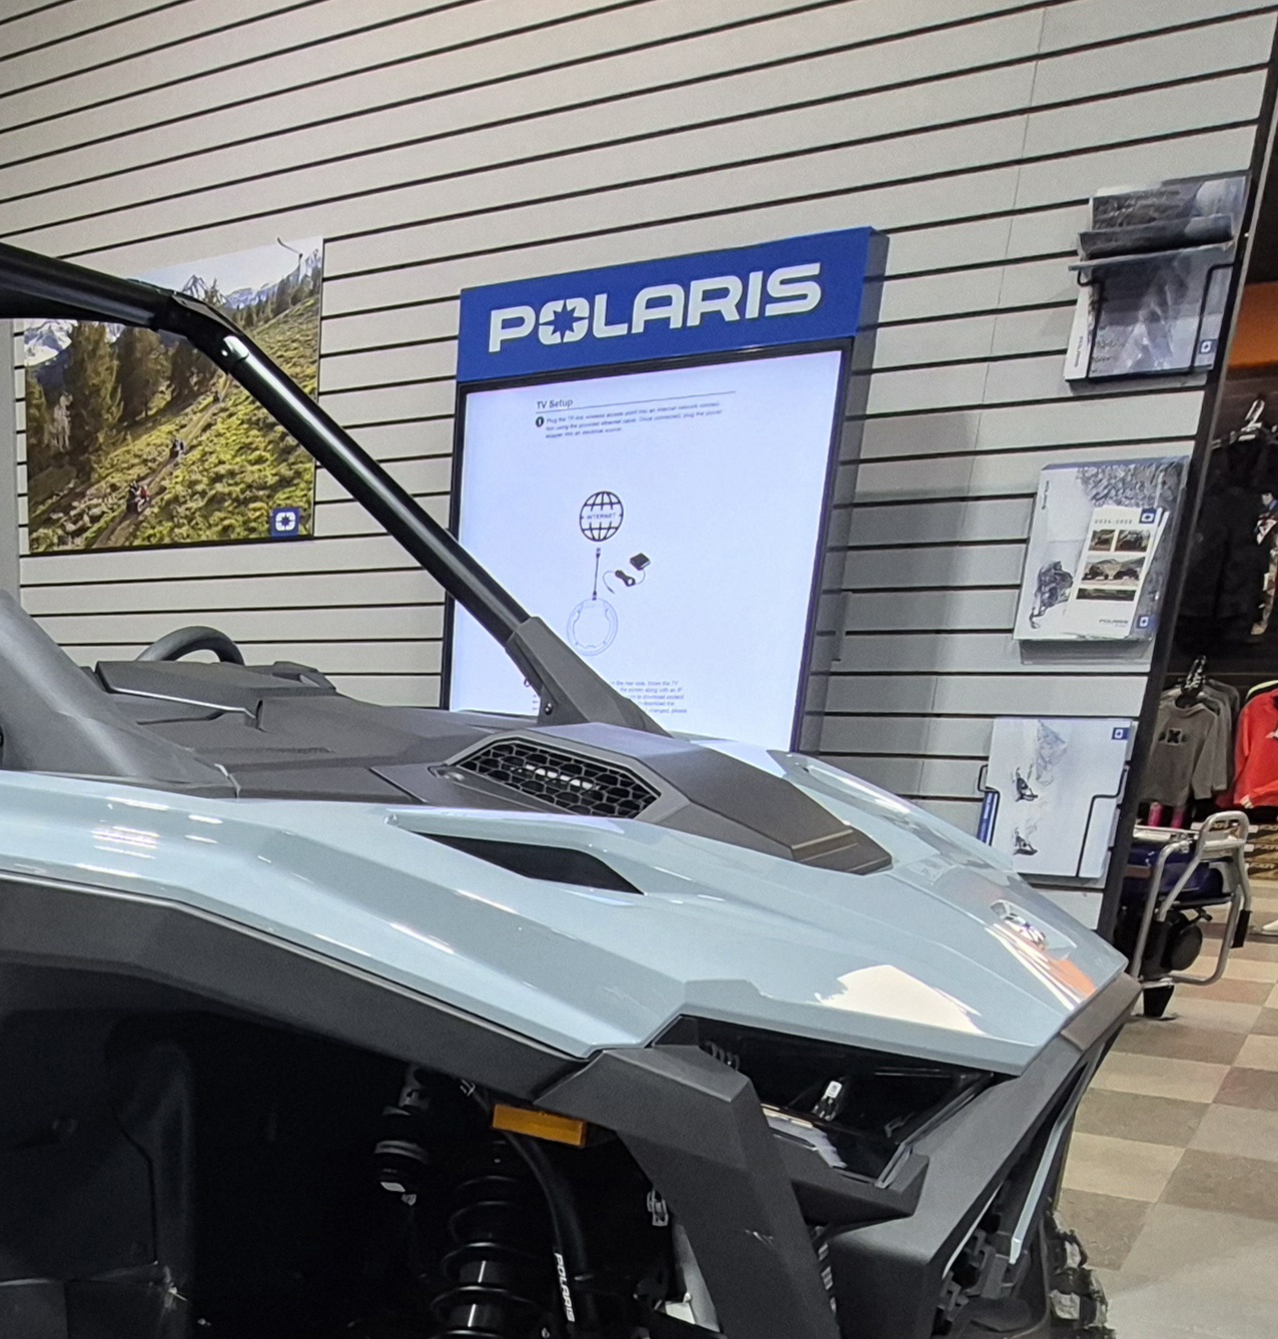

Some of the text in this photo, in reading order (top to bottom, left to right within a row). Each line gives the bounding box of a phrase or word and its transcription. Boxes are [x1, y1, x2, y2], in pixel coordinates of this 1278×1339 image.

[488, 261, 822, 353] POLARIS
[536, 399, 573, 409] TV Setup
[554, 1252, 575, 1322] POLARIS
